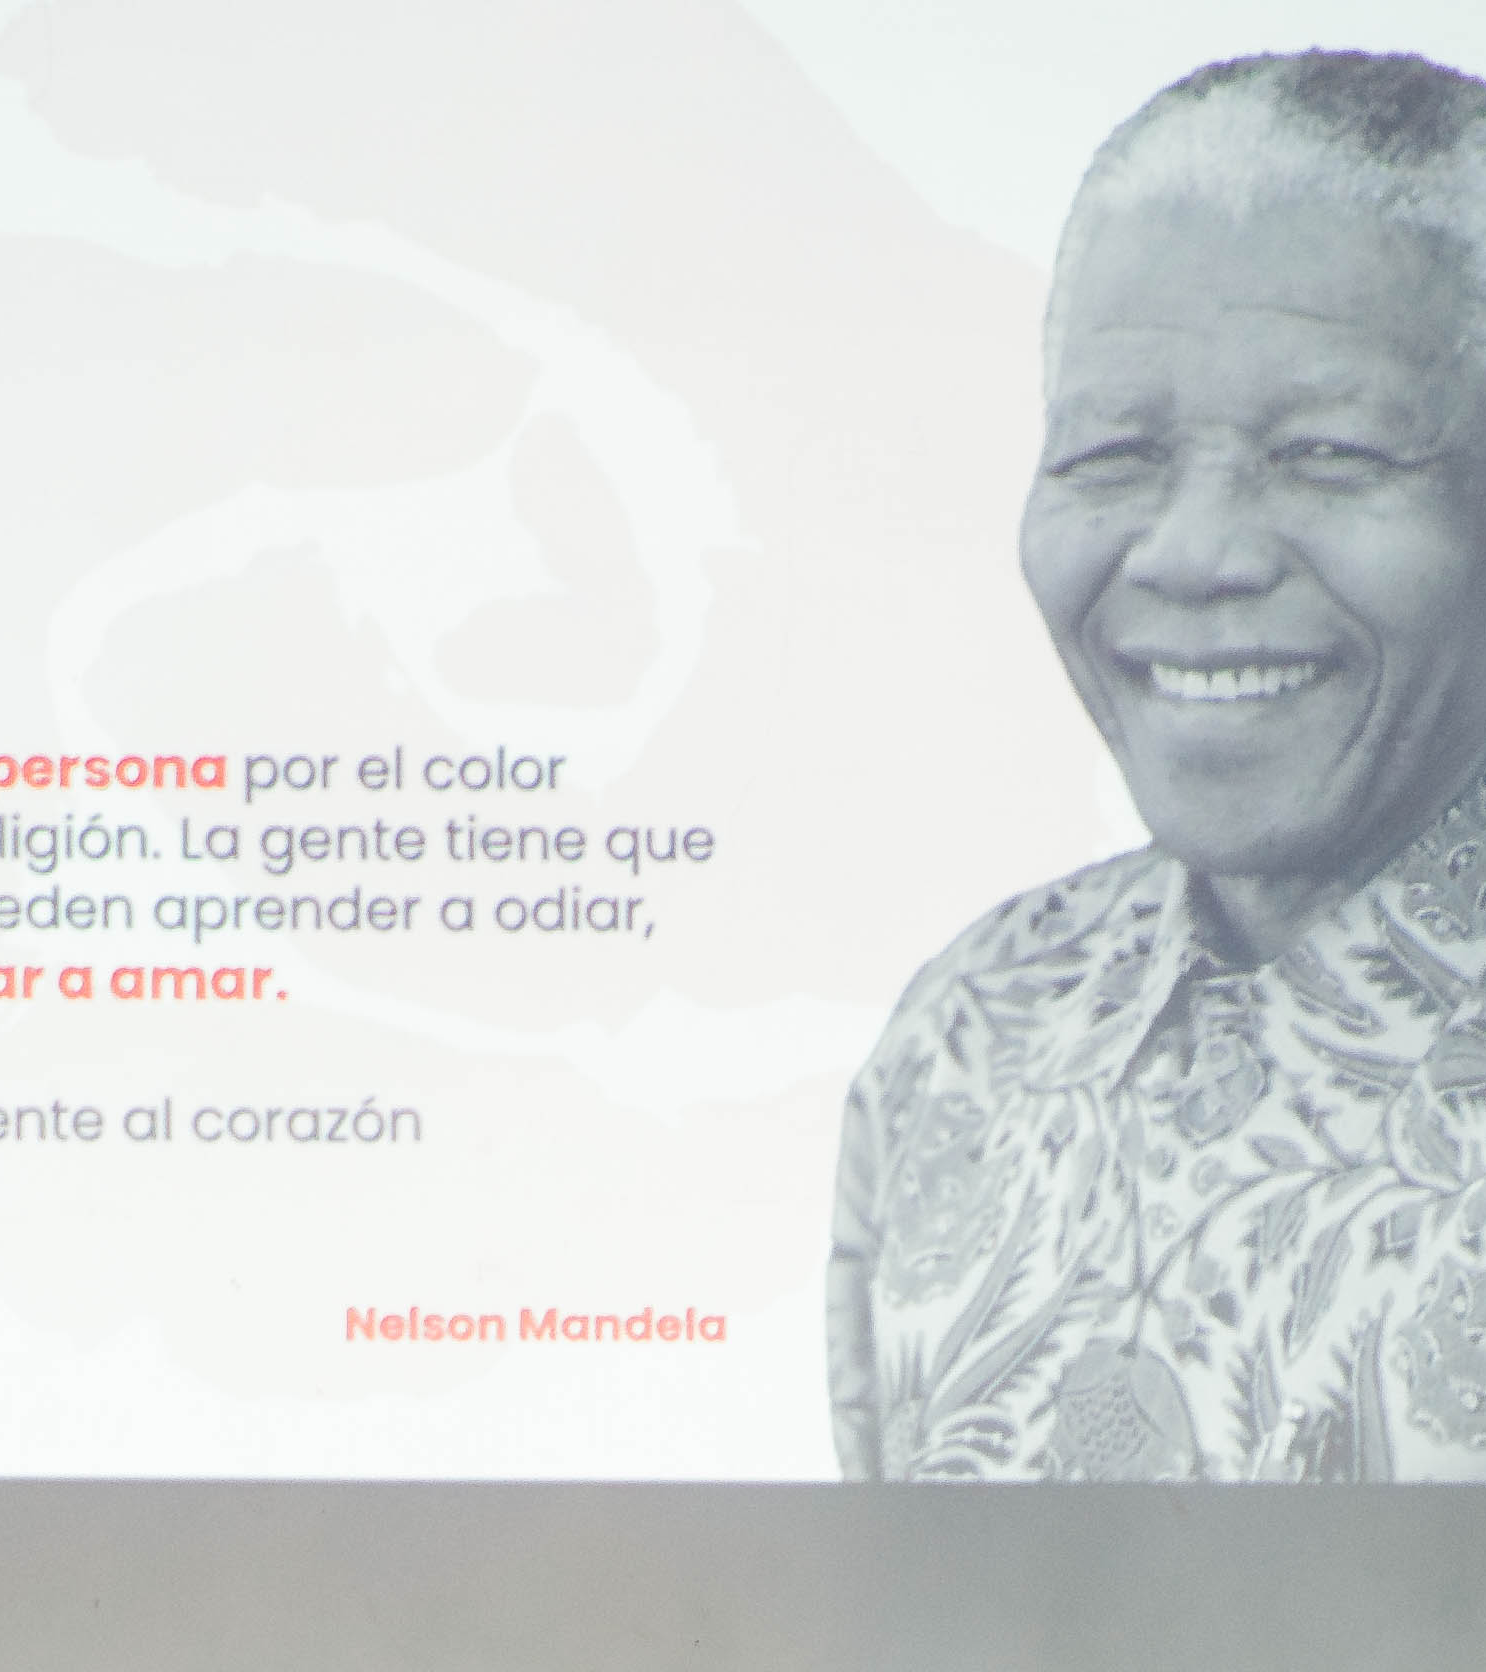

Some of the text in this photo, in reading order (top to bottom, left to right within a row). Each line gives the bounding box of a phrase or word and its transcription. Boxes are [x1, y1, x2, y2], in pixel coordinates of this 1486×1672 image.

[245, 755, 339, 804] por
[357, 746, 403, 791] el
[423, 746, 566, 792] color
[181, 818, 240, 861] La
[260, 819, 426, 876] gente
[445, 815, 587, 863] tiene
[605, 827, 715, 876] que
[153, 886, 421, 945] aprender
[440, 896, 474, 932] a
[494, 886, 654, 939] odiar,
[57, 965, 94, 1001] a
[109, 966, 288, 1002] amar.
[123, 1098, 172, 1142] al
[192, 1098, 421, 1143] corazón
[346, 1306, 726, 1342] Nelson Mandela
